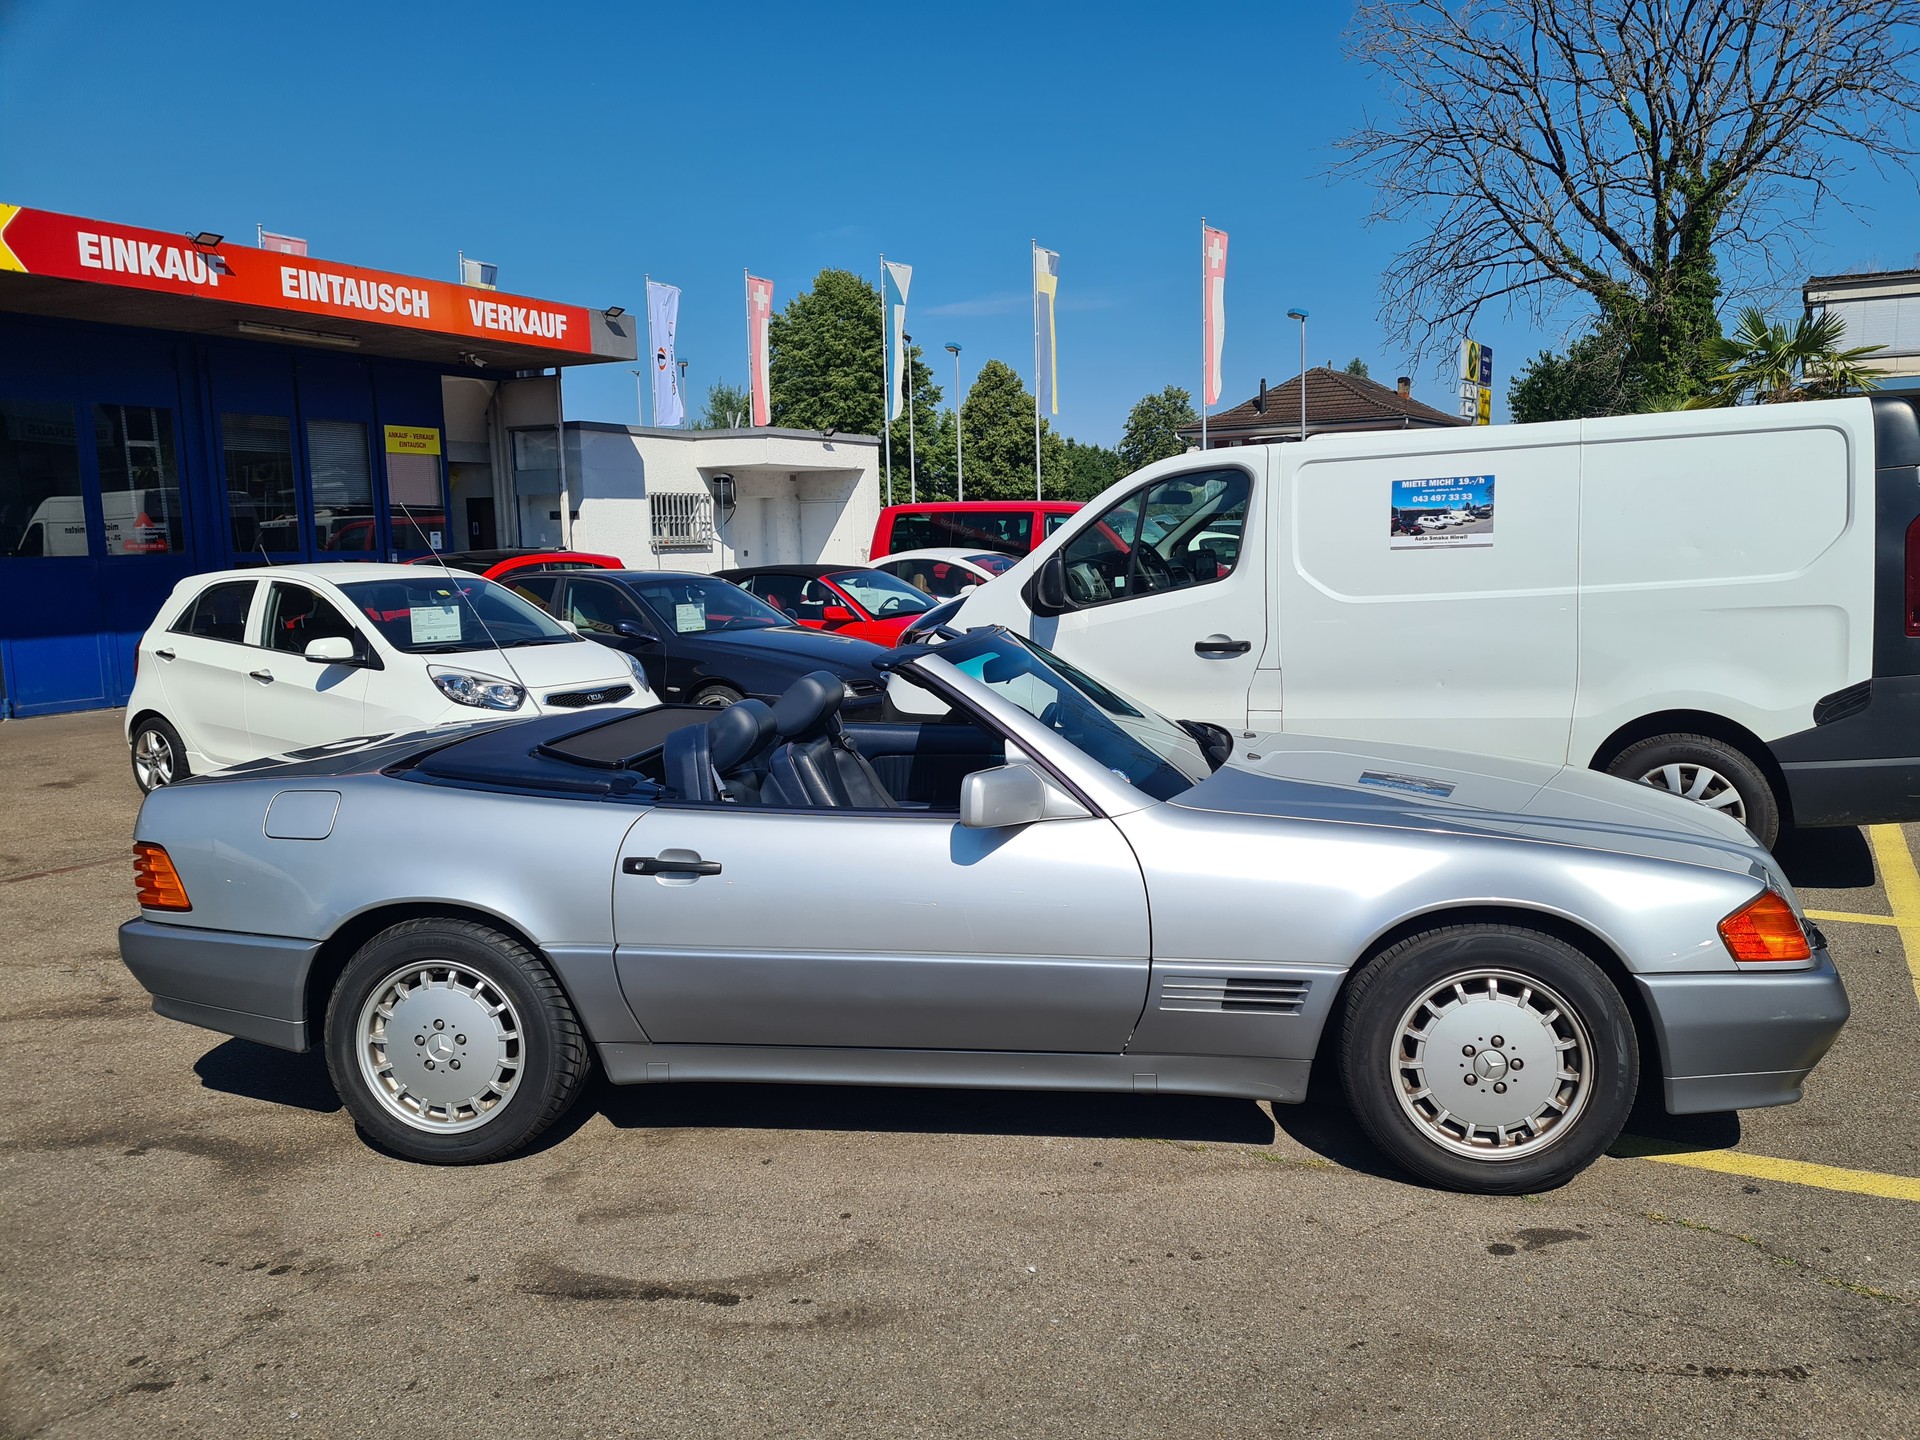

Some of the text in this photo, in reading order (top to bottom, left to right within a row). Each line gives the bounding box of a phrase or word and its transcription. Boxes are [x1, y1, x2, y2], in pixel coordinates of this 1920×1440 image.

[77, 231, 567, 340] EINKAUF EINTAUSCH VERKAUF
[388, 431, 408, 439] ANKAUF
[413, 433, 436, 441] VERKAUF
[399, 440, 427, 449] EINTAUSCH
[1401, 480, 1427, 489] MIETE
[1428, 478, 1454, 487] MICH!
[1412, 492, 1473, 503] 043 497 33 33
